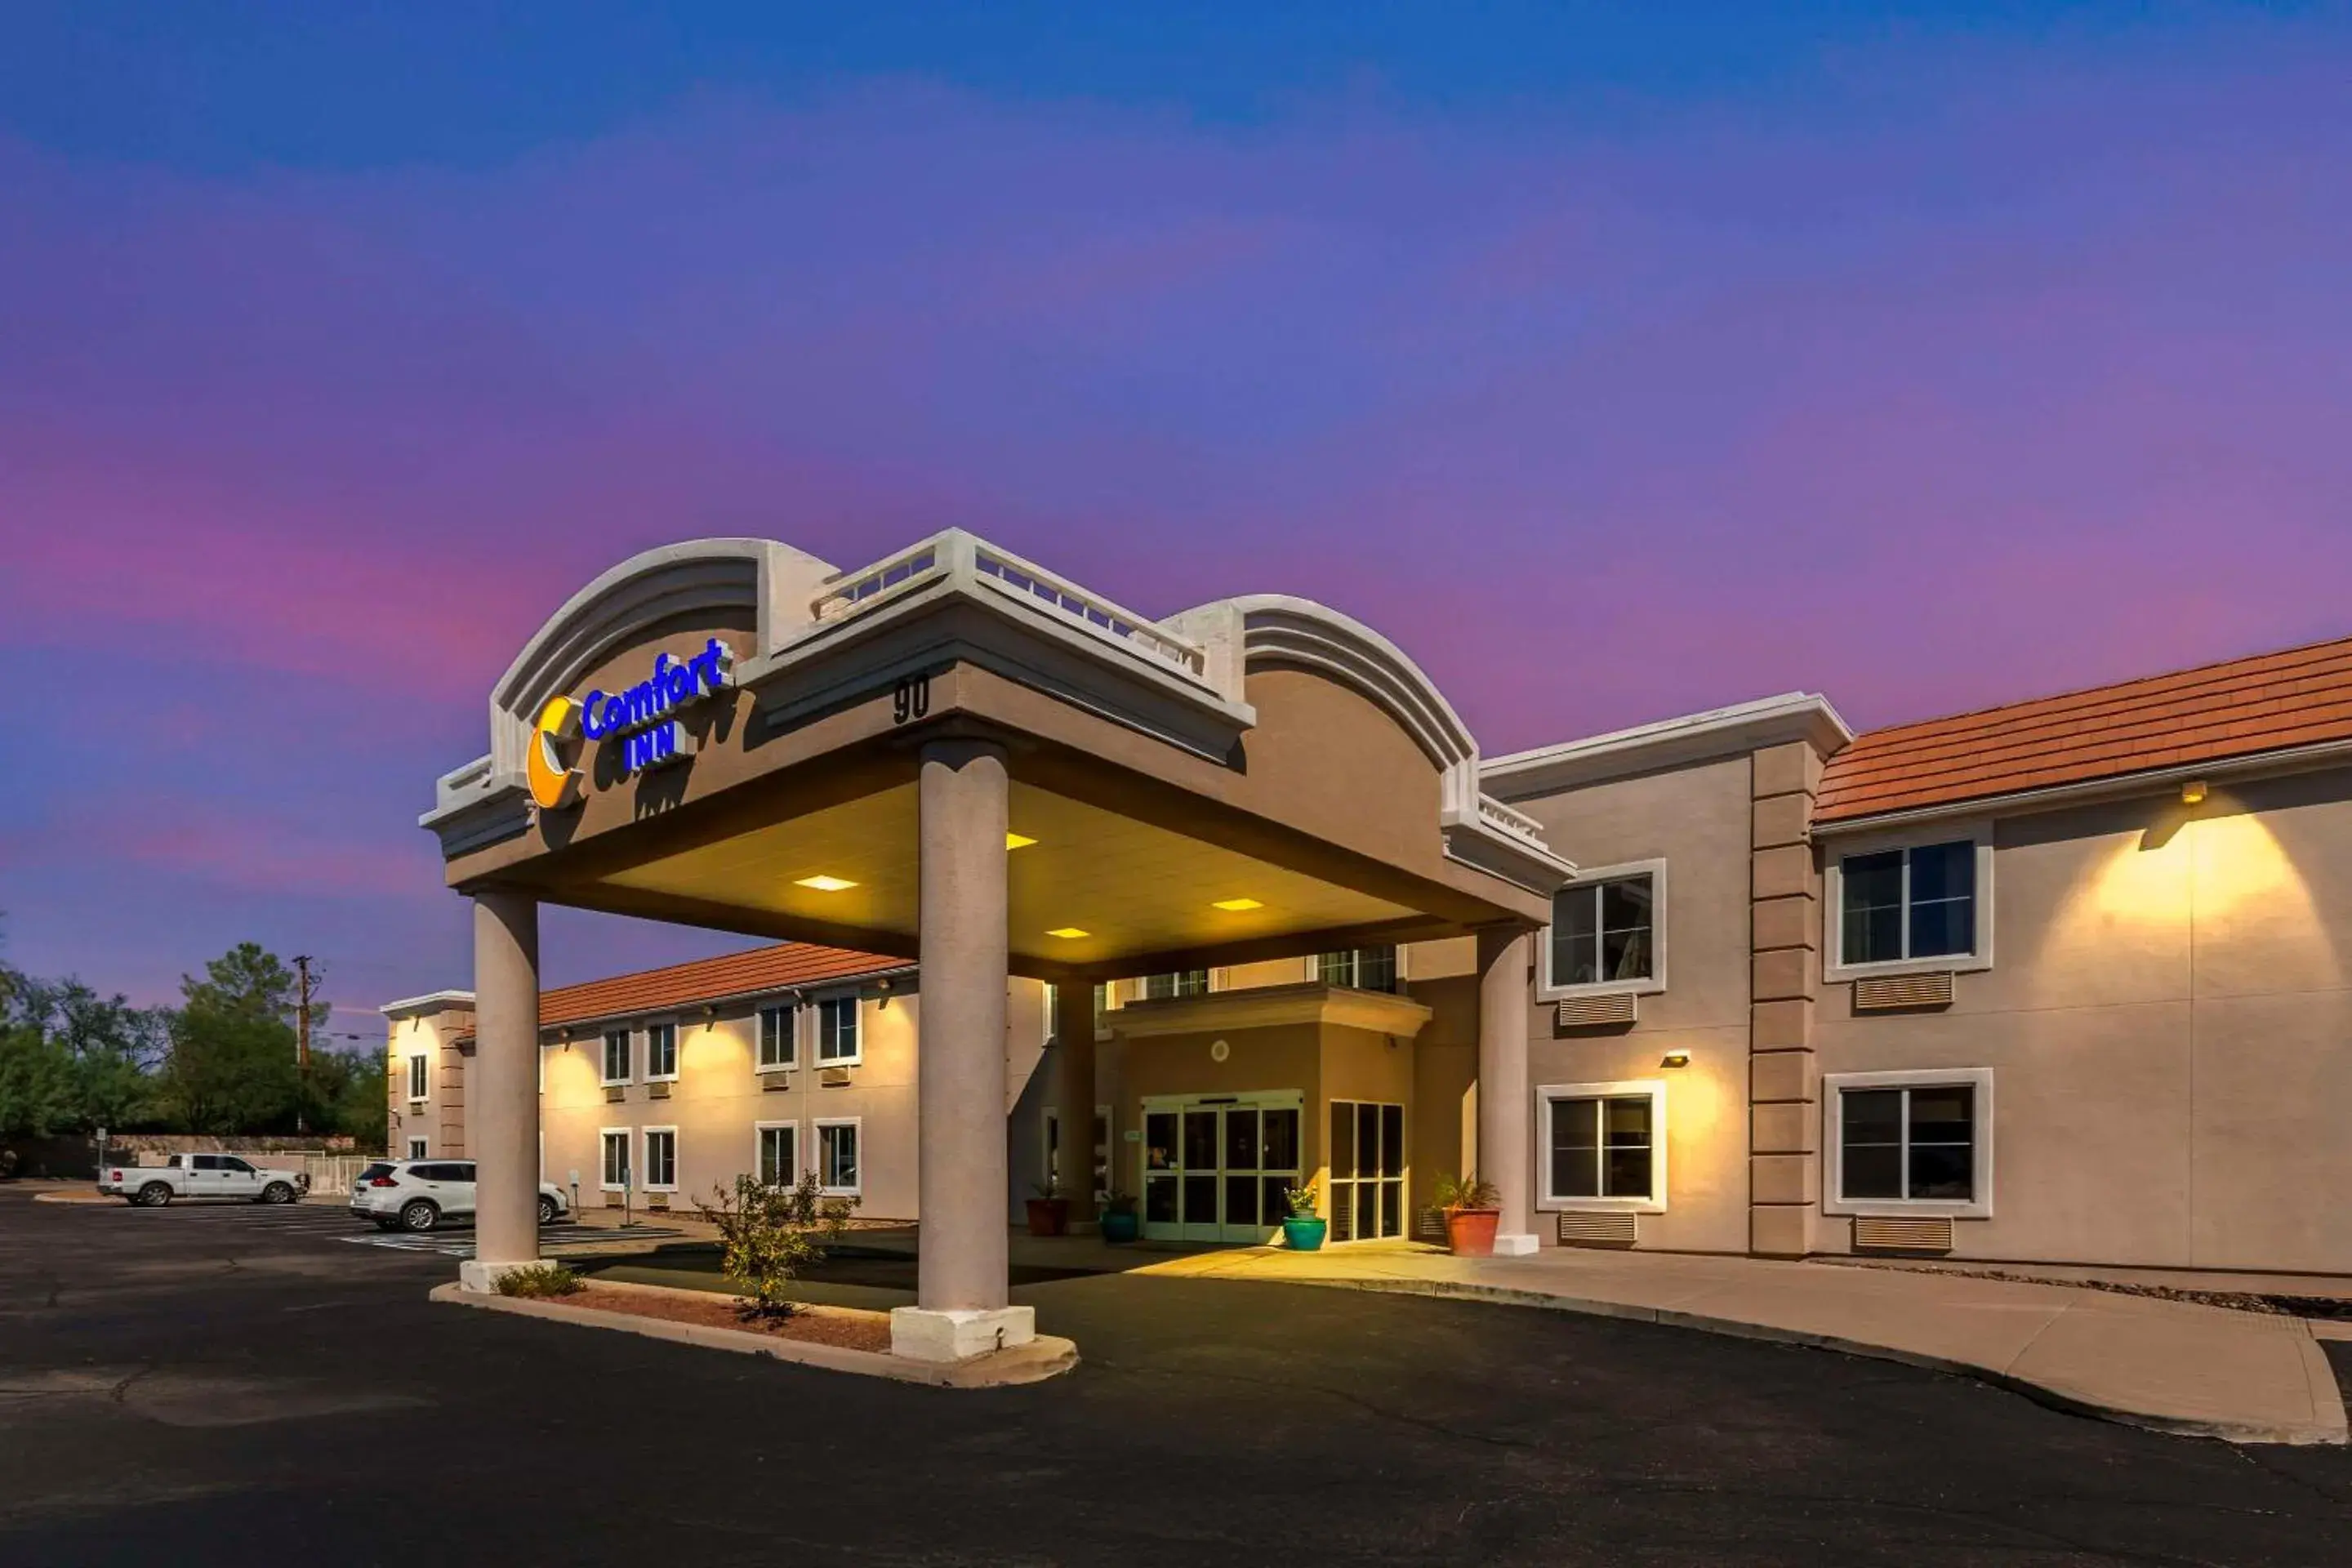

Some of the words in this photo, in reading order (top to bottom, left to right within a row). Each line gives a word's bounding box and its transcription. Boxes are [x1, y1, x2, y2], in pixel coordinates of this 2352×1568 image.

[581, 638, 724, 740] Comfort
[893, 675, 929, 724] 90
[624, 719, 676, 772] INN
